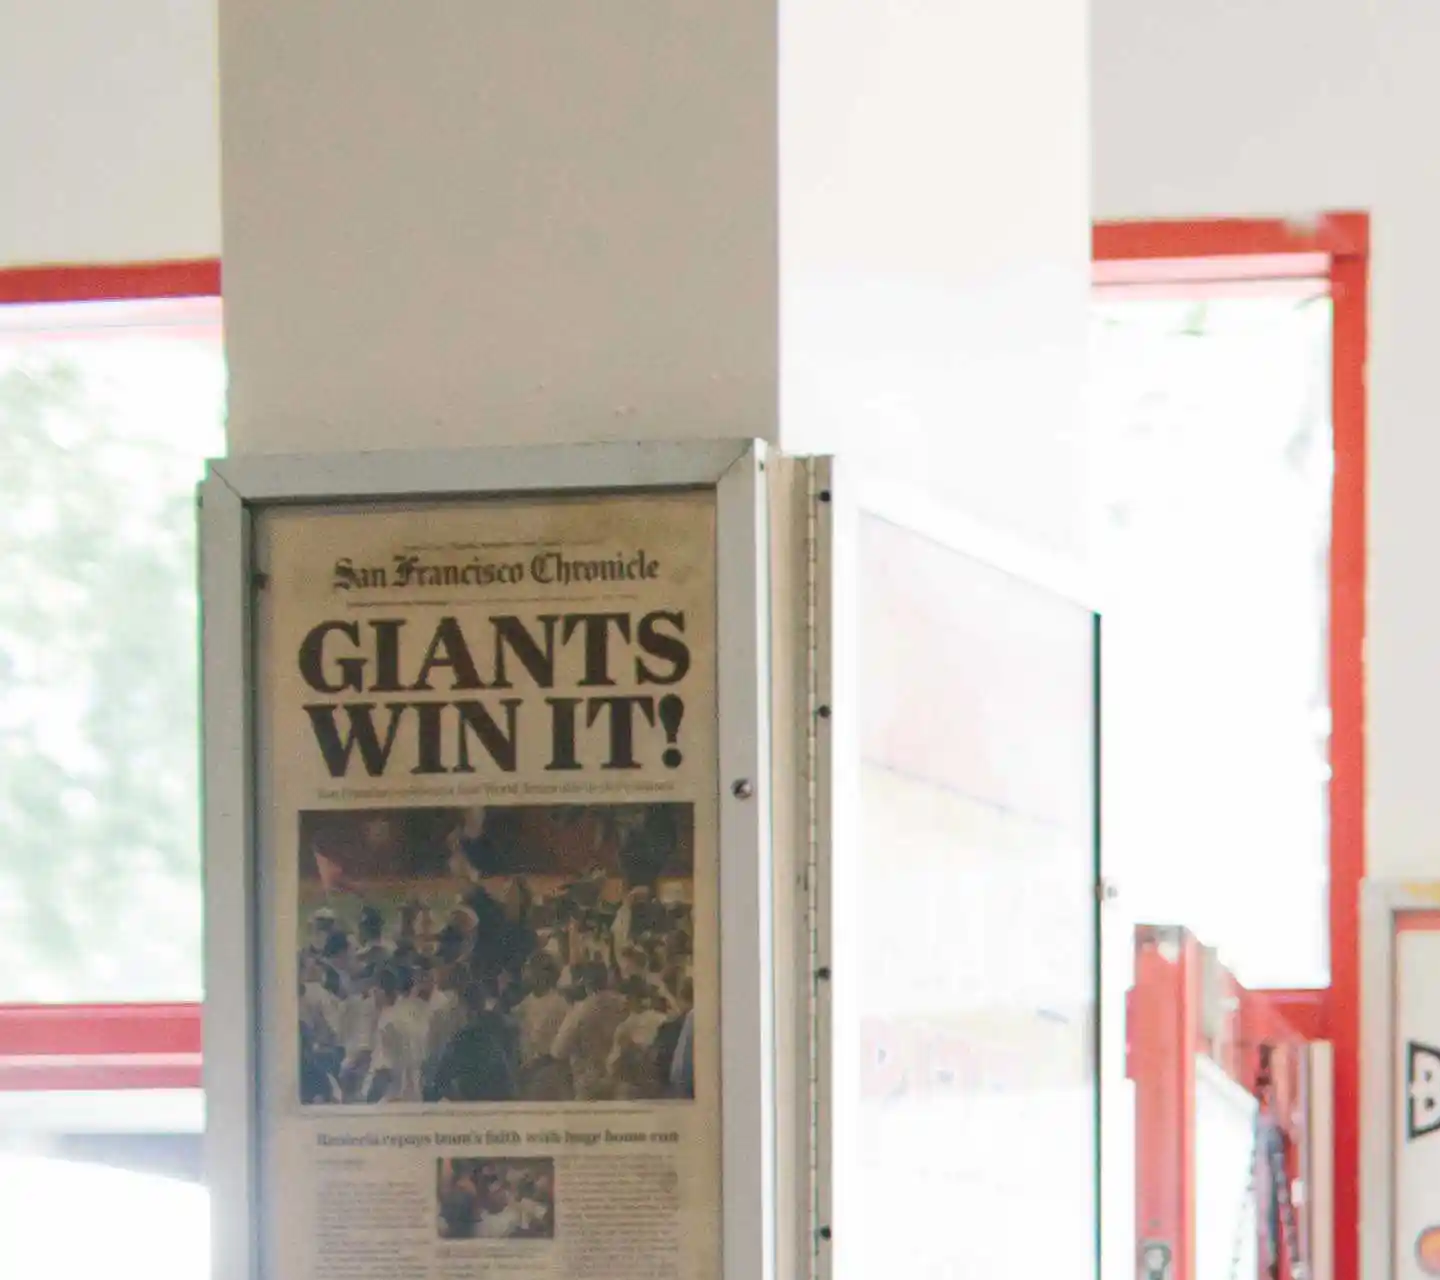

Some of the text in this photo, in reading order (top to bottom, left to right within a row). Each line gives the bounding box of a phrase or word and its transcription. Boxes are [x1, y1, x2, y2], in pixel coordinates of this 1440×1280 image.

[333, 548, 660, 590] San Francisco Chronicle
[298, 609, 691, 694] GIANTS
[302, 693, 686, 778] WIN IT!
